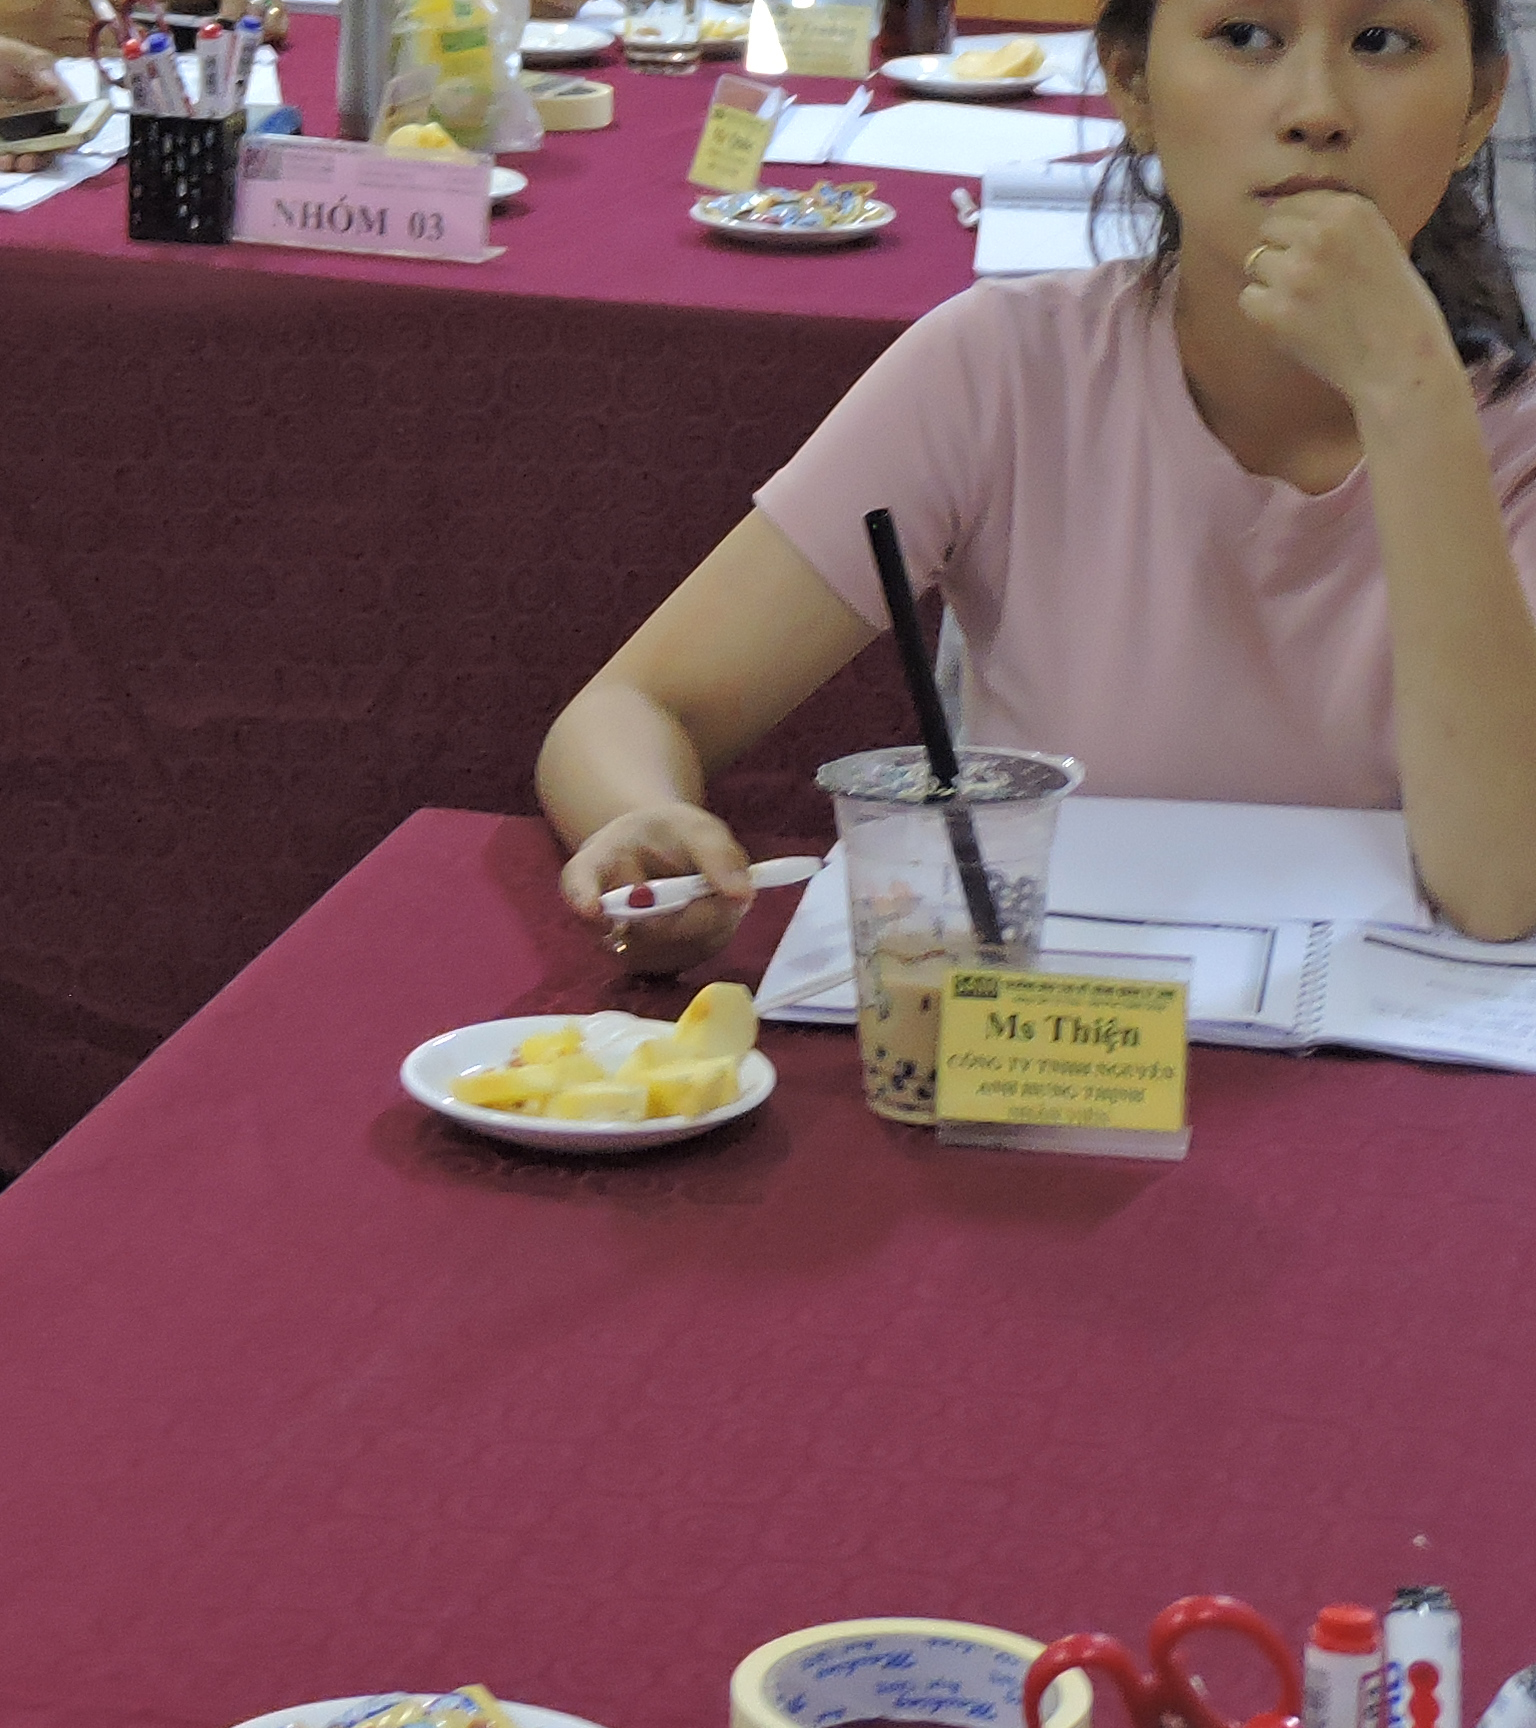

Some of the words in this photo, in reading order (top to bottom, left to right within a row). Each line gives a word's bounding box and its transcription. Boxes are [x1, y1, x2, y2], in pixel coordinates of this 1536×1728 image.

[274, 194, 389, 237] NHÓM
[408, 211, 446, 242] 03
[985, 1011, 1036, 1043] Ms
